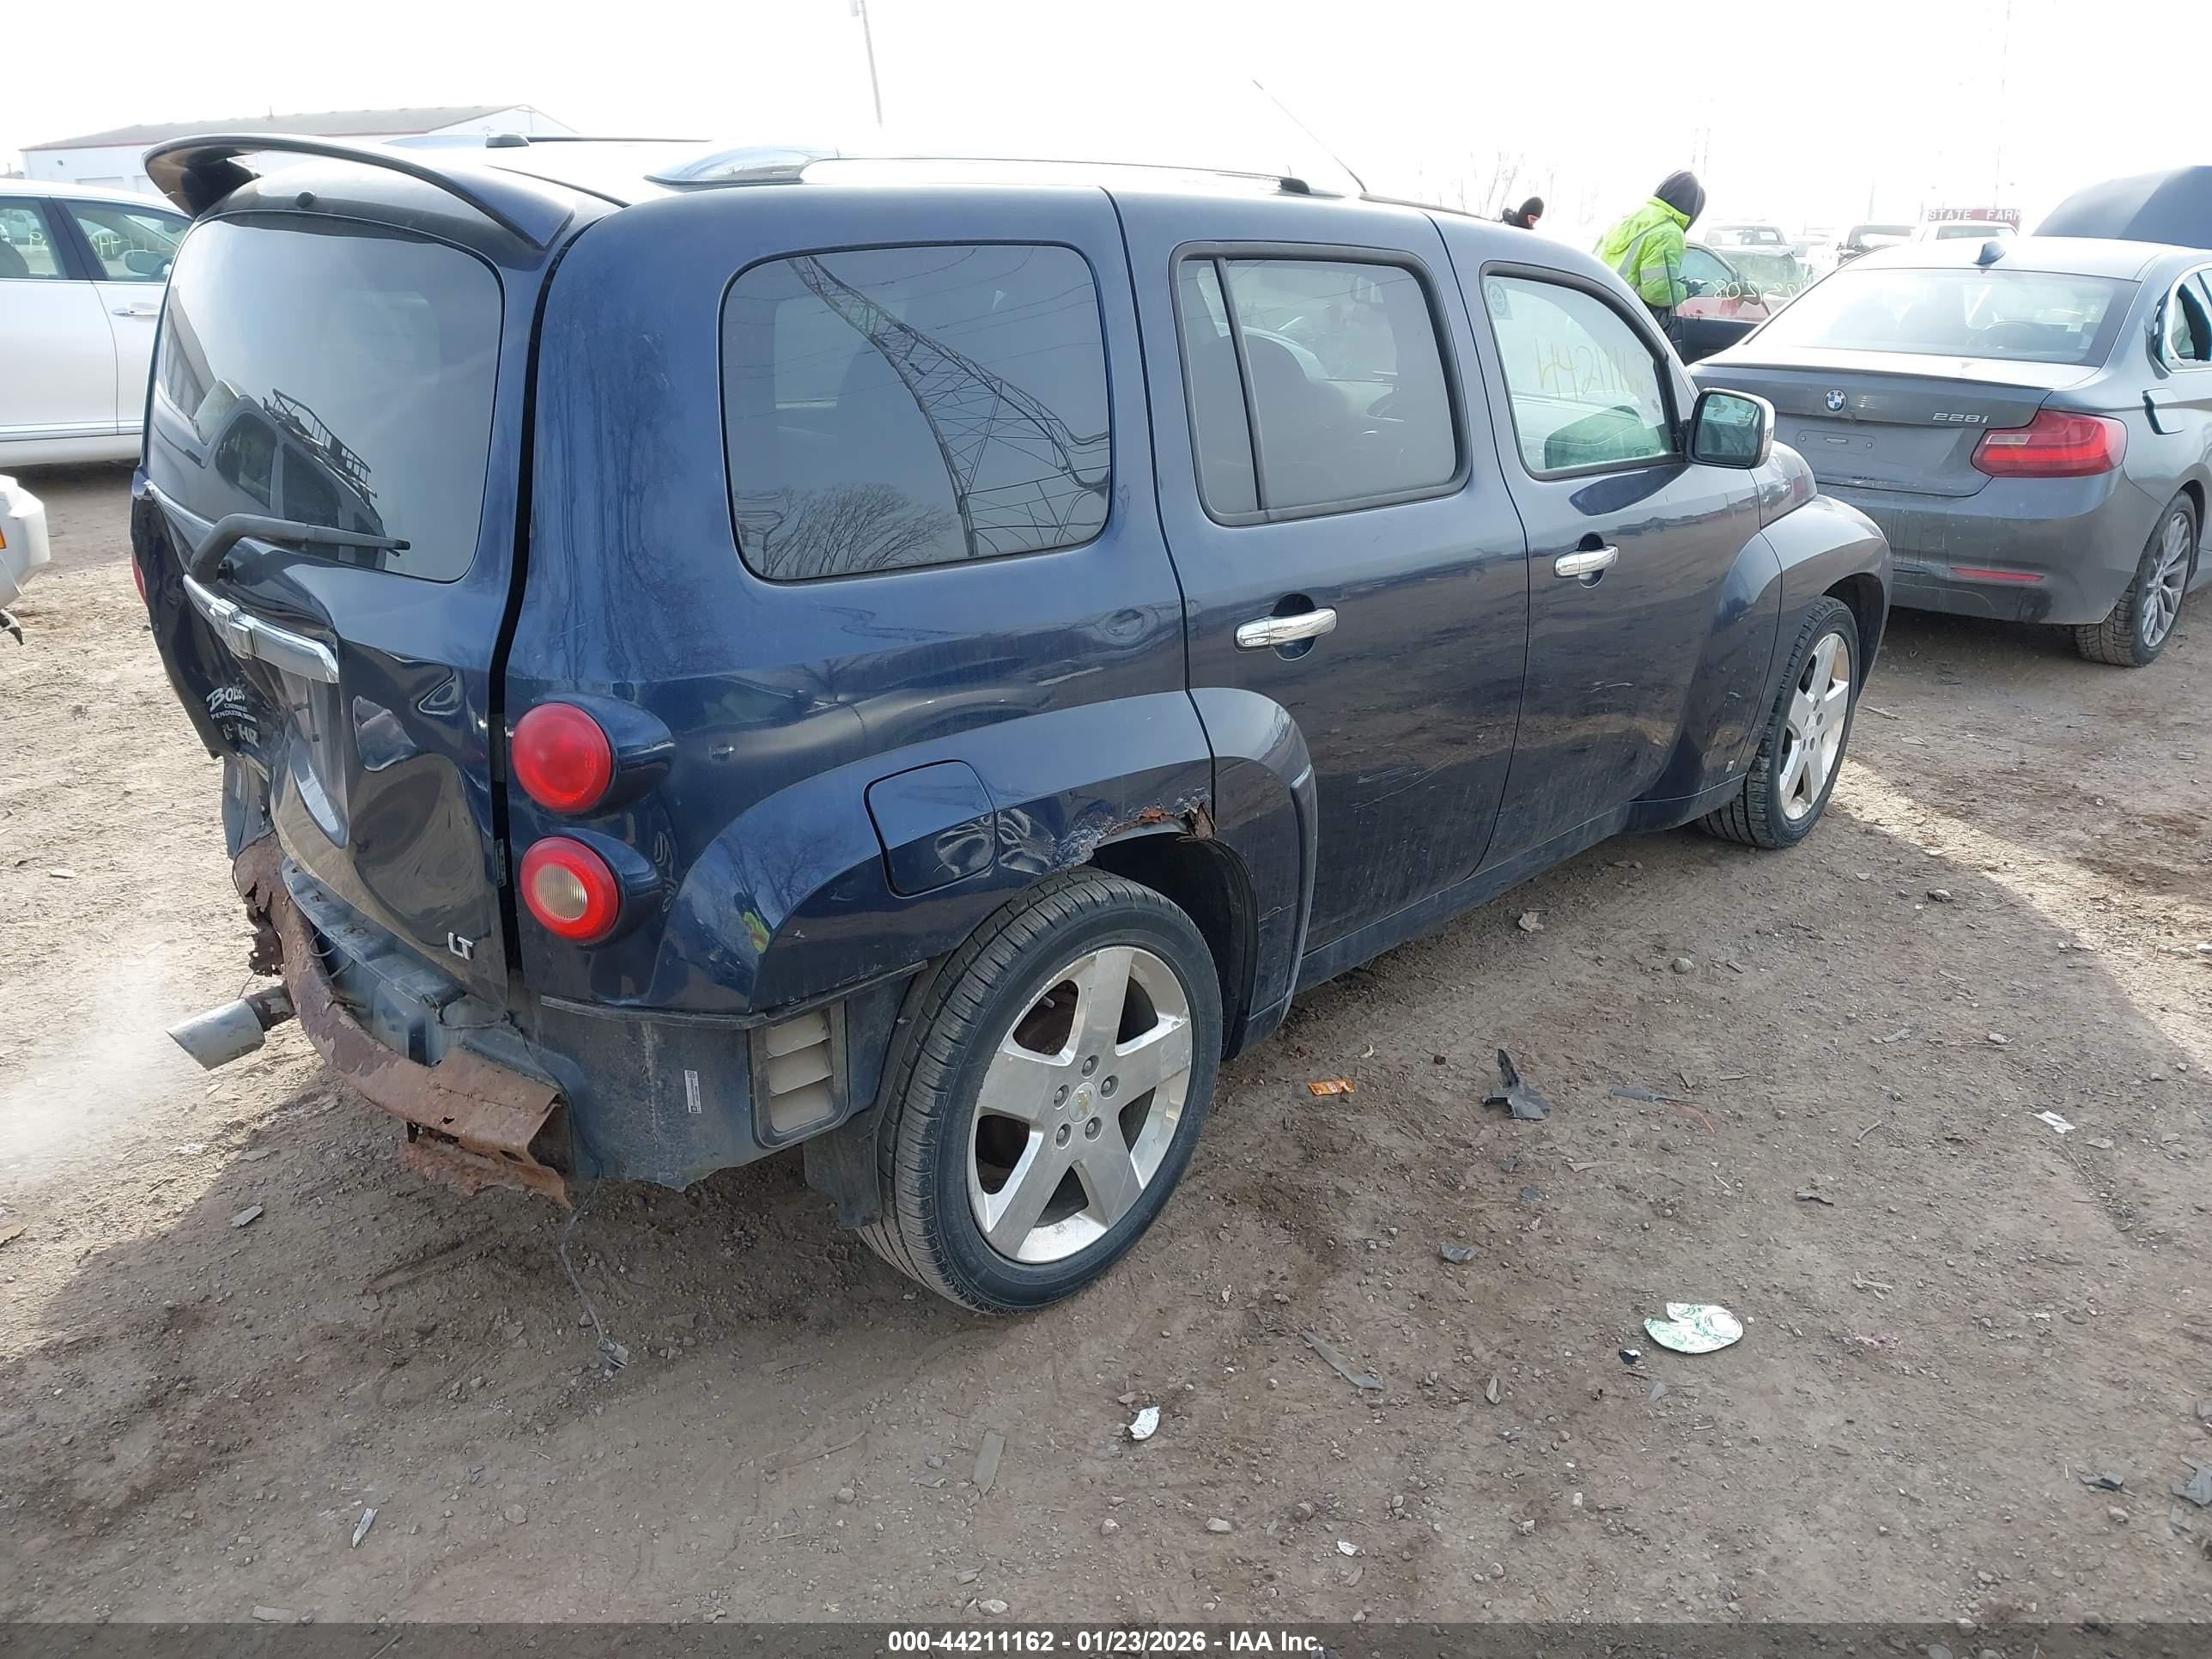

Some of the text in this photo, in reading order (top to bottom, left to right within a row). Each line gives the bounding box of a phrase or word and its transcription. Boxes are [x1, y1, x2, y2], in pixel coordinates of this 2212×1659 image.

[1929, 209, 1972, 221] STATE
[1932, 412, 1990, 424] 228i
[447, 932, 474, 960] LT
